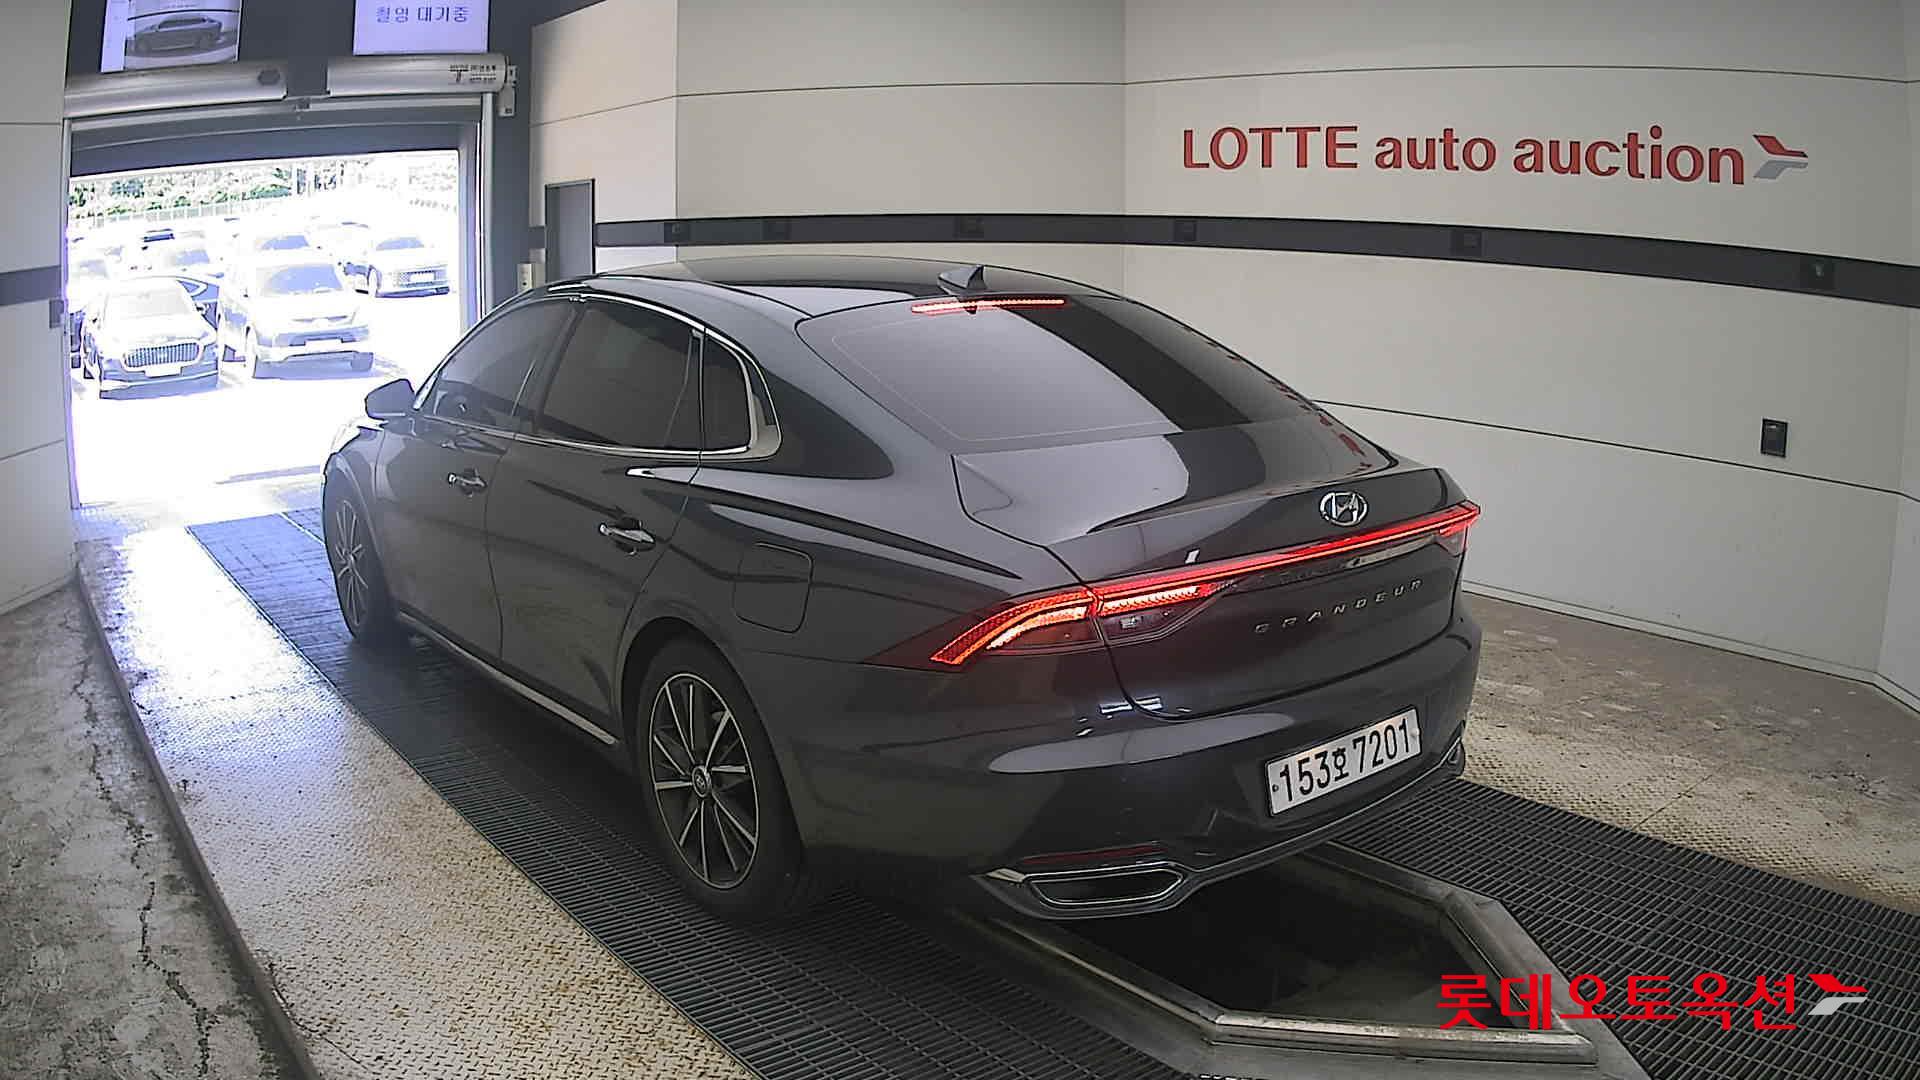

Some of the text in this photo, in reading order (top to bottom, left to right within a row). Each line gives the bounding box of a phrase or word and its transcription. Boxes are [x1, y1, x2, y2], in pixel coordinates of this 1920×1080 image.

[417, 6, 469, 23] 대기중
[1183, 125, 1745, 185] LOTTE auto auction
[1255, 579, 1422, 633] GRANDEUR
[1279, 718, 1410, 802] 153호 7201
